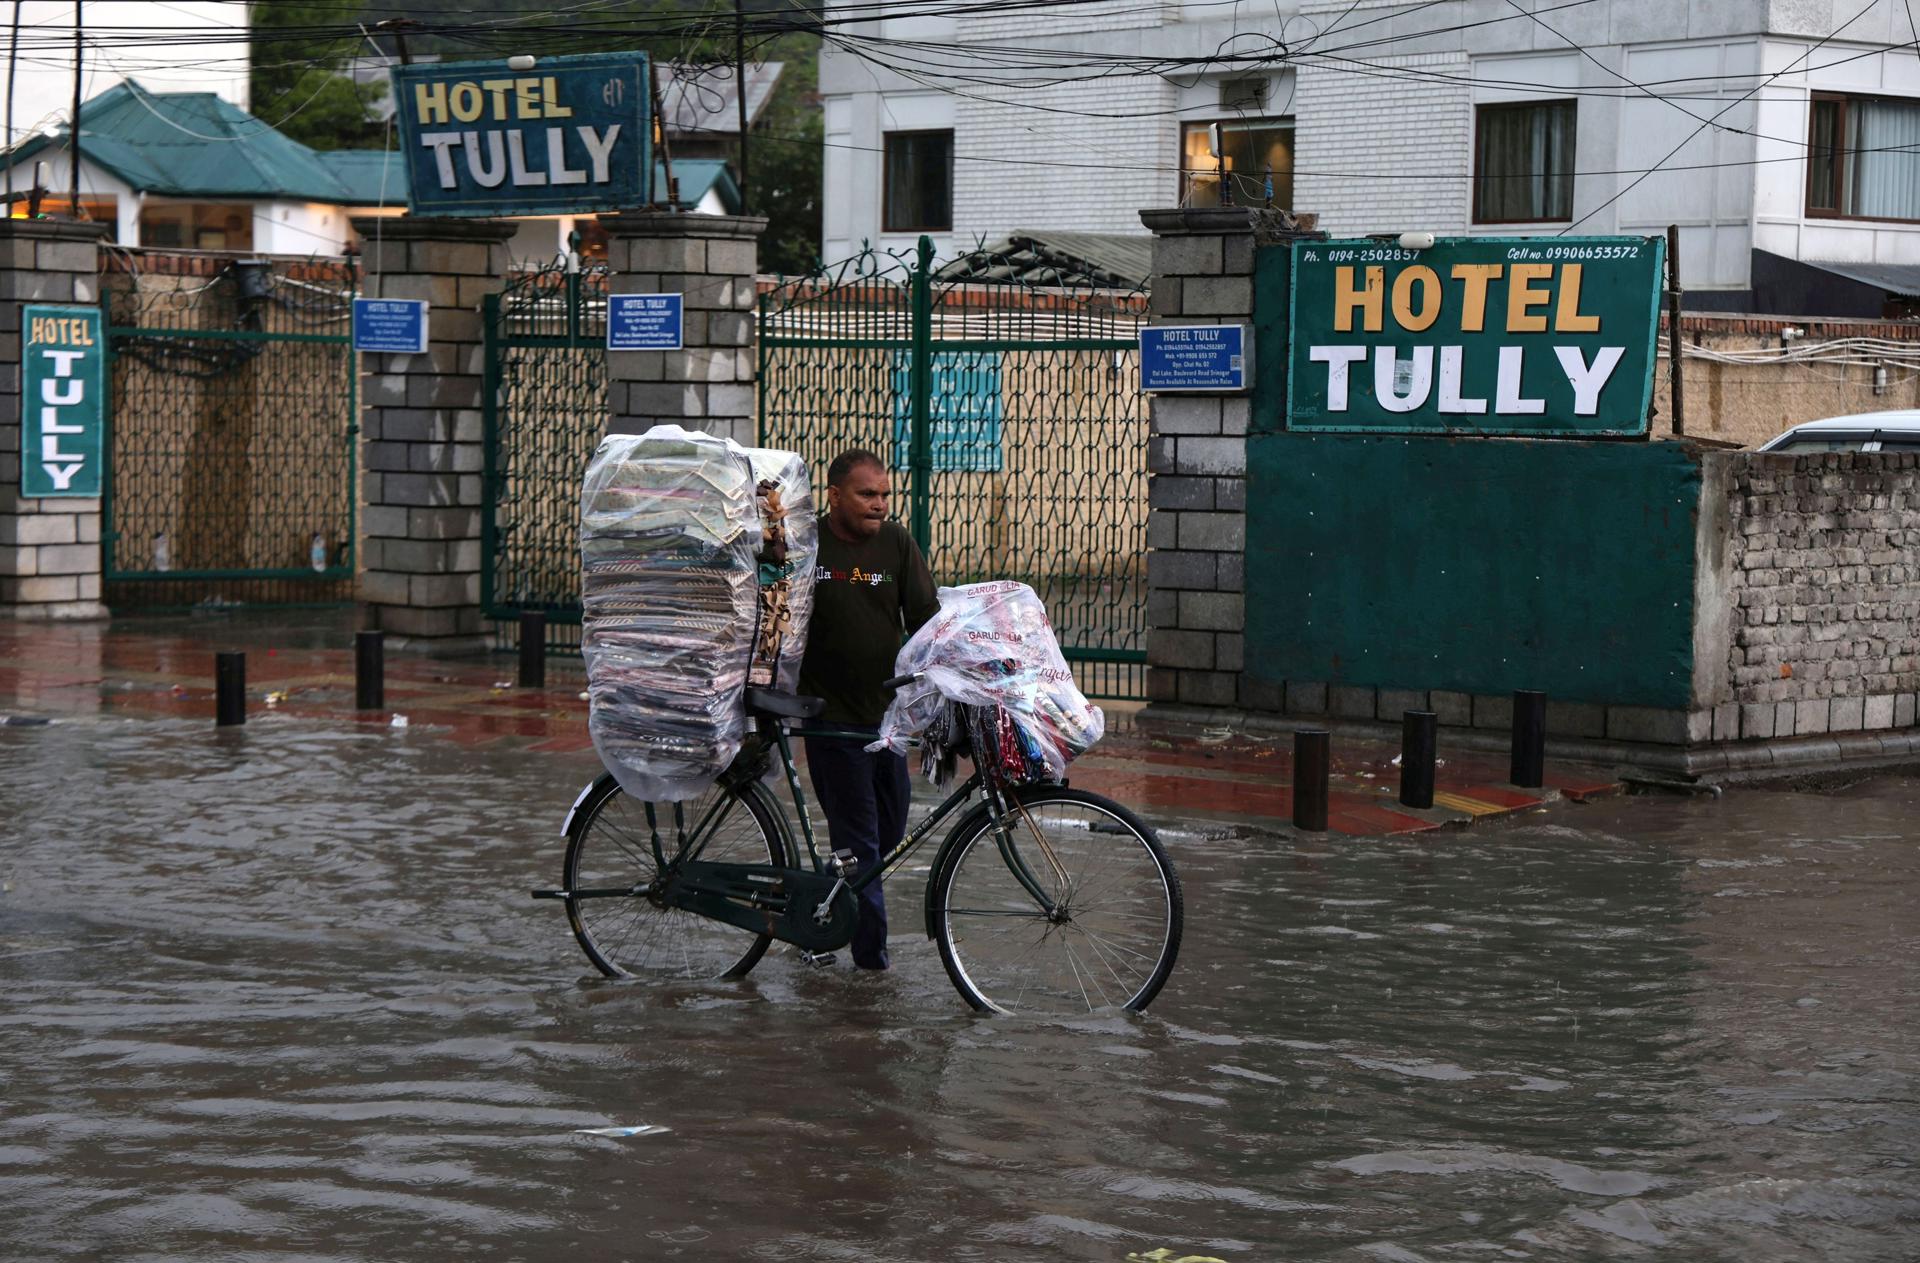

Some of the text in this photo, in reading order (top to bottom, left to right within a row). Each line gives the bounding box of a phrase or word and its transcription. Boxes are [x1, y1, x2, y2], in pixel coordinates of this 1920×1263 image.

[414, 76, 572, 124] HOTEL
[421, 124, 621, 189] TULLY
[1304, 249, 1420, 262] Ph. 0194-2502857
[1507, 247, 1528, 260] Cell
[1546, 246, 1638, 259] 09906653572
[1333, 263, 1601, 332] HOTEL
[31, 317, 93, 347] HOTEL
[1163, 330, 1220, 341] HOTEL TULLY
[1309, 345, 1626, 415] TULLY
[41, 350, 85, 490] TULLY
[850, 567, 893, 586] Angels
[967, 584, 998, 596] GARUD
[968, 631, 1001, 641] GARUD
